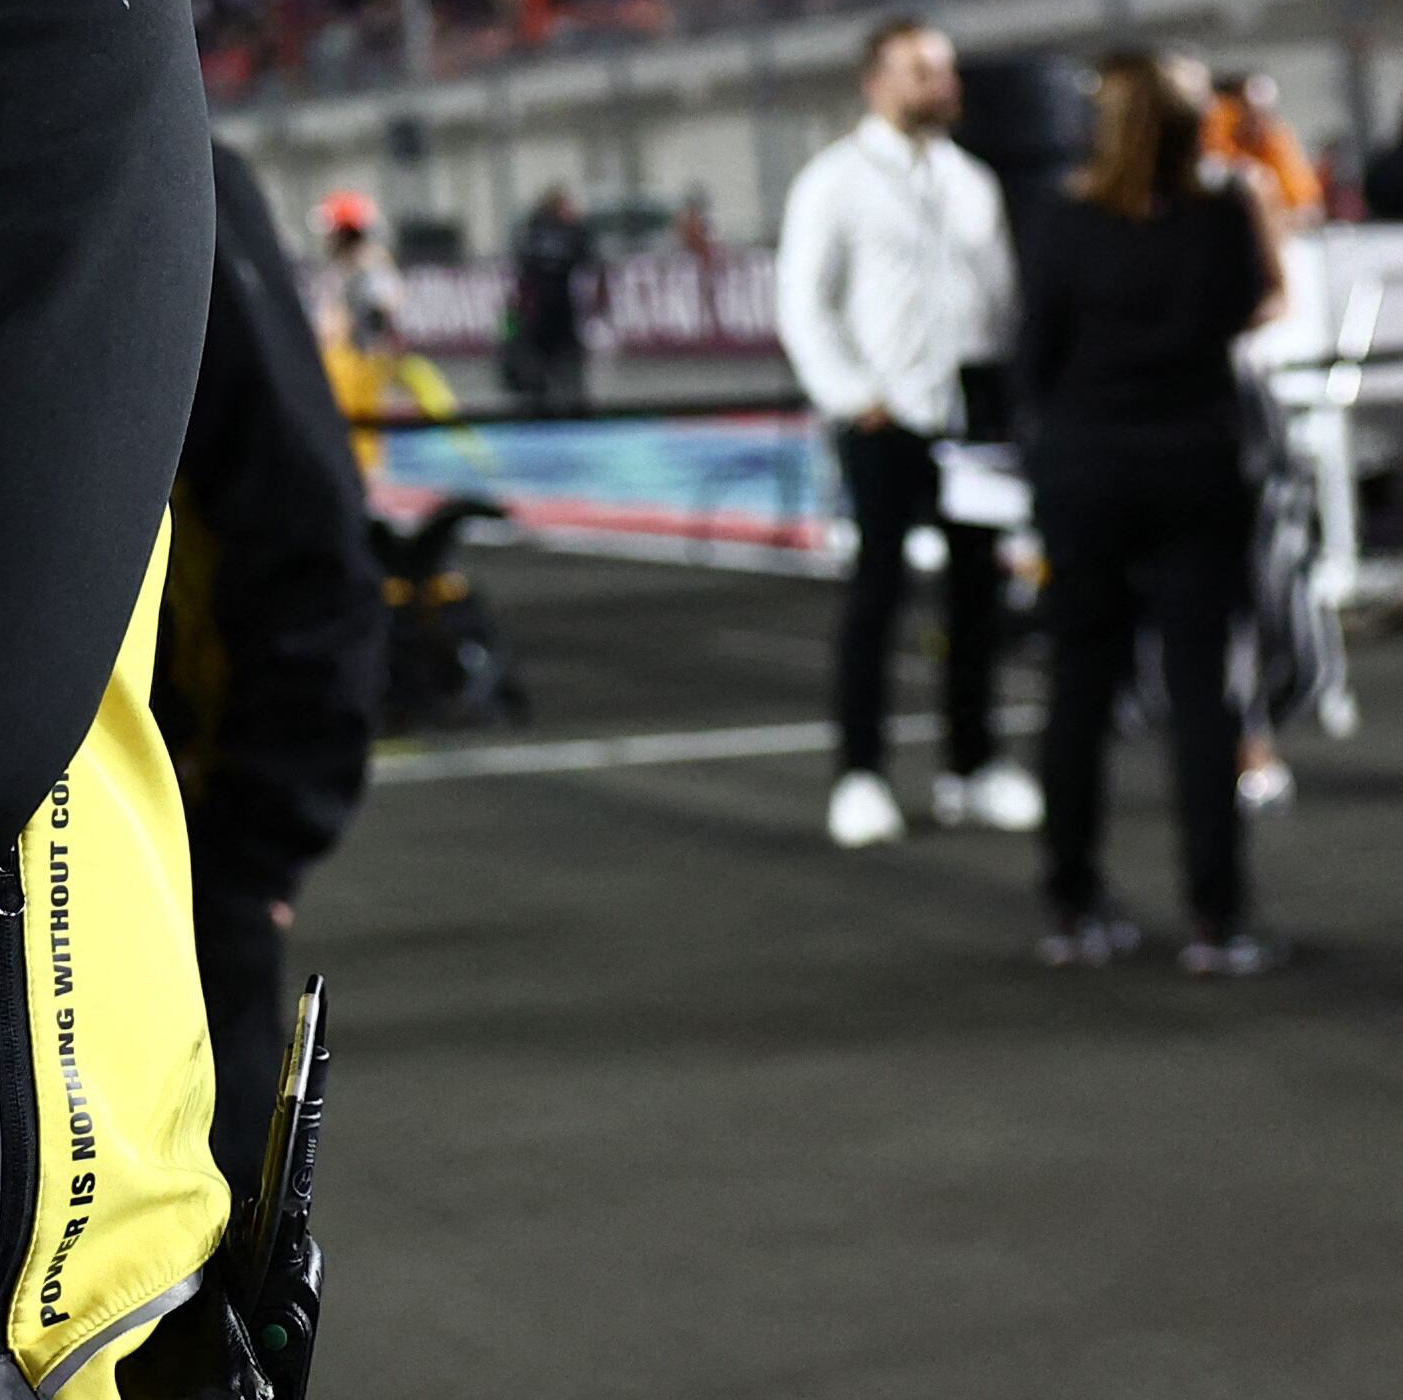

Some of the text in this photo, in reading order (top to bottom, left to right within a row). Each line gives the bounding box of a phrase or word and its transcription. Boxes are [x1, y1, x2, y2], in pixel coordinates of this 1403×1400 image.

[50, 840, 74, 997] WITHOUT
[56, 1008, 97, 1162] NOTHING
[69, 1172, 96, 1207] IS
[40, 1216, 90, 1329] POWER
